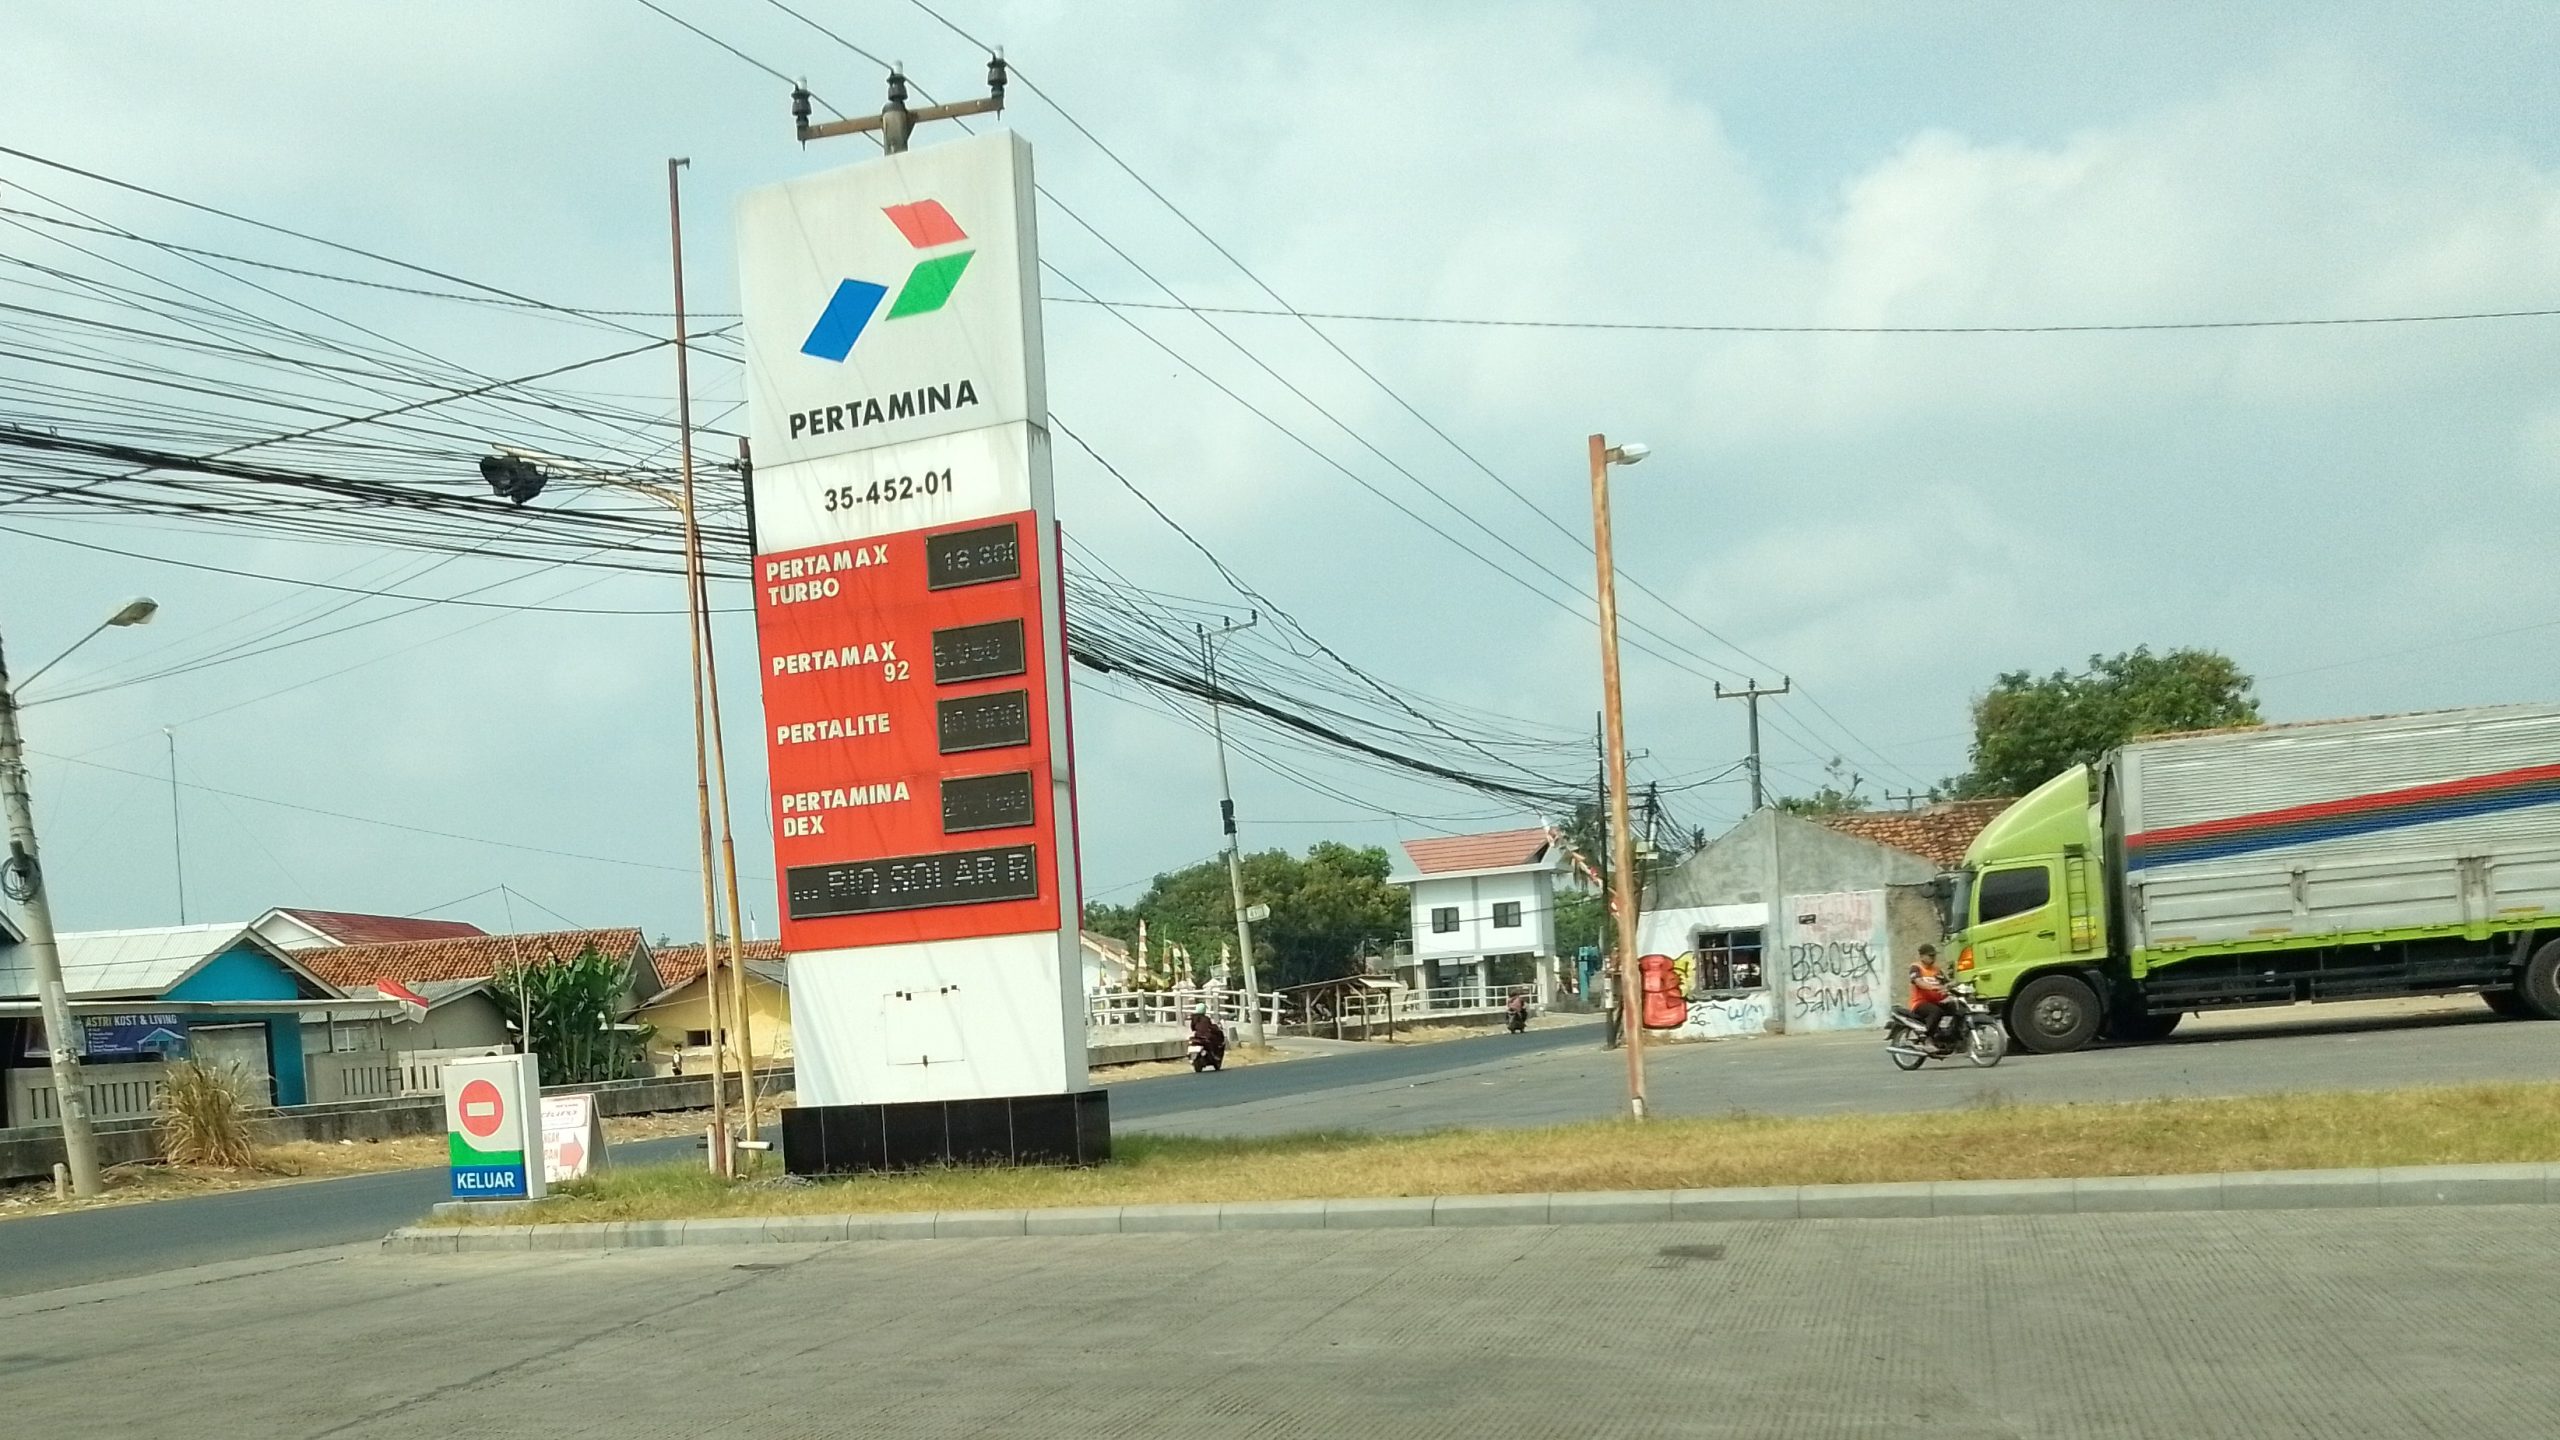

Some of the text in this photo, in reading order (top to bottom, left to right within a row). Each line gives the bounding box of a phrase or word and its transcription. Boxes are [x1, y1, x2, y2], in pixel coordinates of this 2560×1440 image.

[789, 379, 979, 440] PERTAMINA
[824, 468, 953, 513] 35-452-01
[765, 544, 889, 582] PERTAMAX
[768, 577, 840, 607] TURBO
[772, 640, 897, 677] PERTAMAX
[884, 661, 910, 683] 92
[776, 712, 891, 745] PERTALITE
[781, 781, 910, 814] PERTAMINA
[783, 816, 825, 838] DEX
[114, 1014, 138, 1026] KOST
[148, 1014, 178, 1025] LIVING
[457, 1171, 516, 1189] KELUAR
